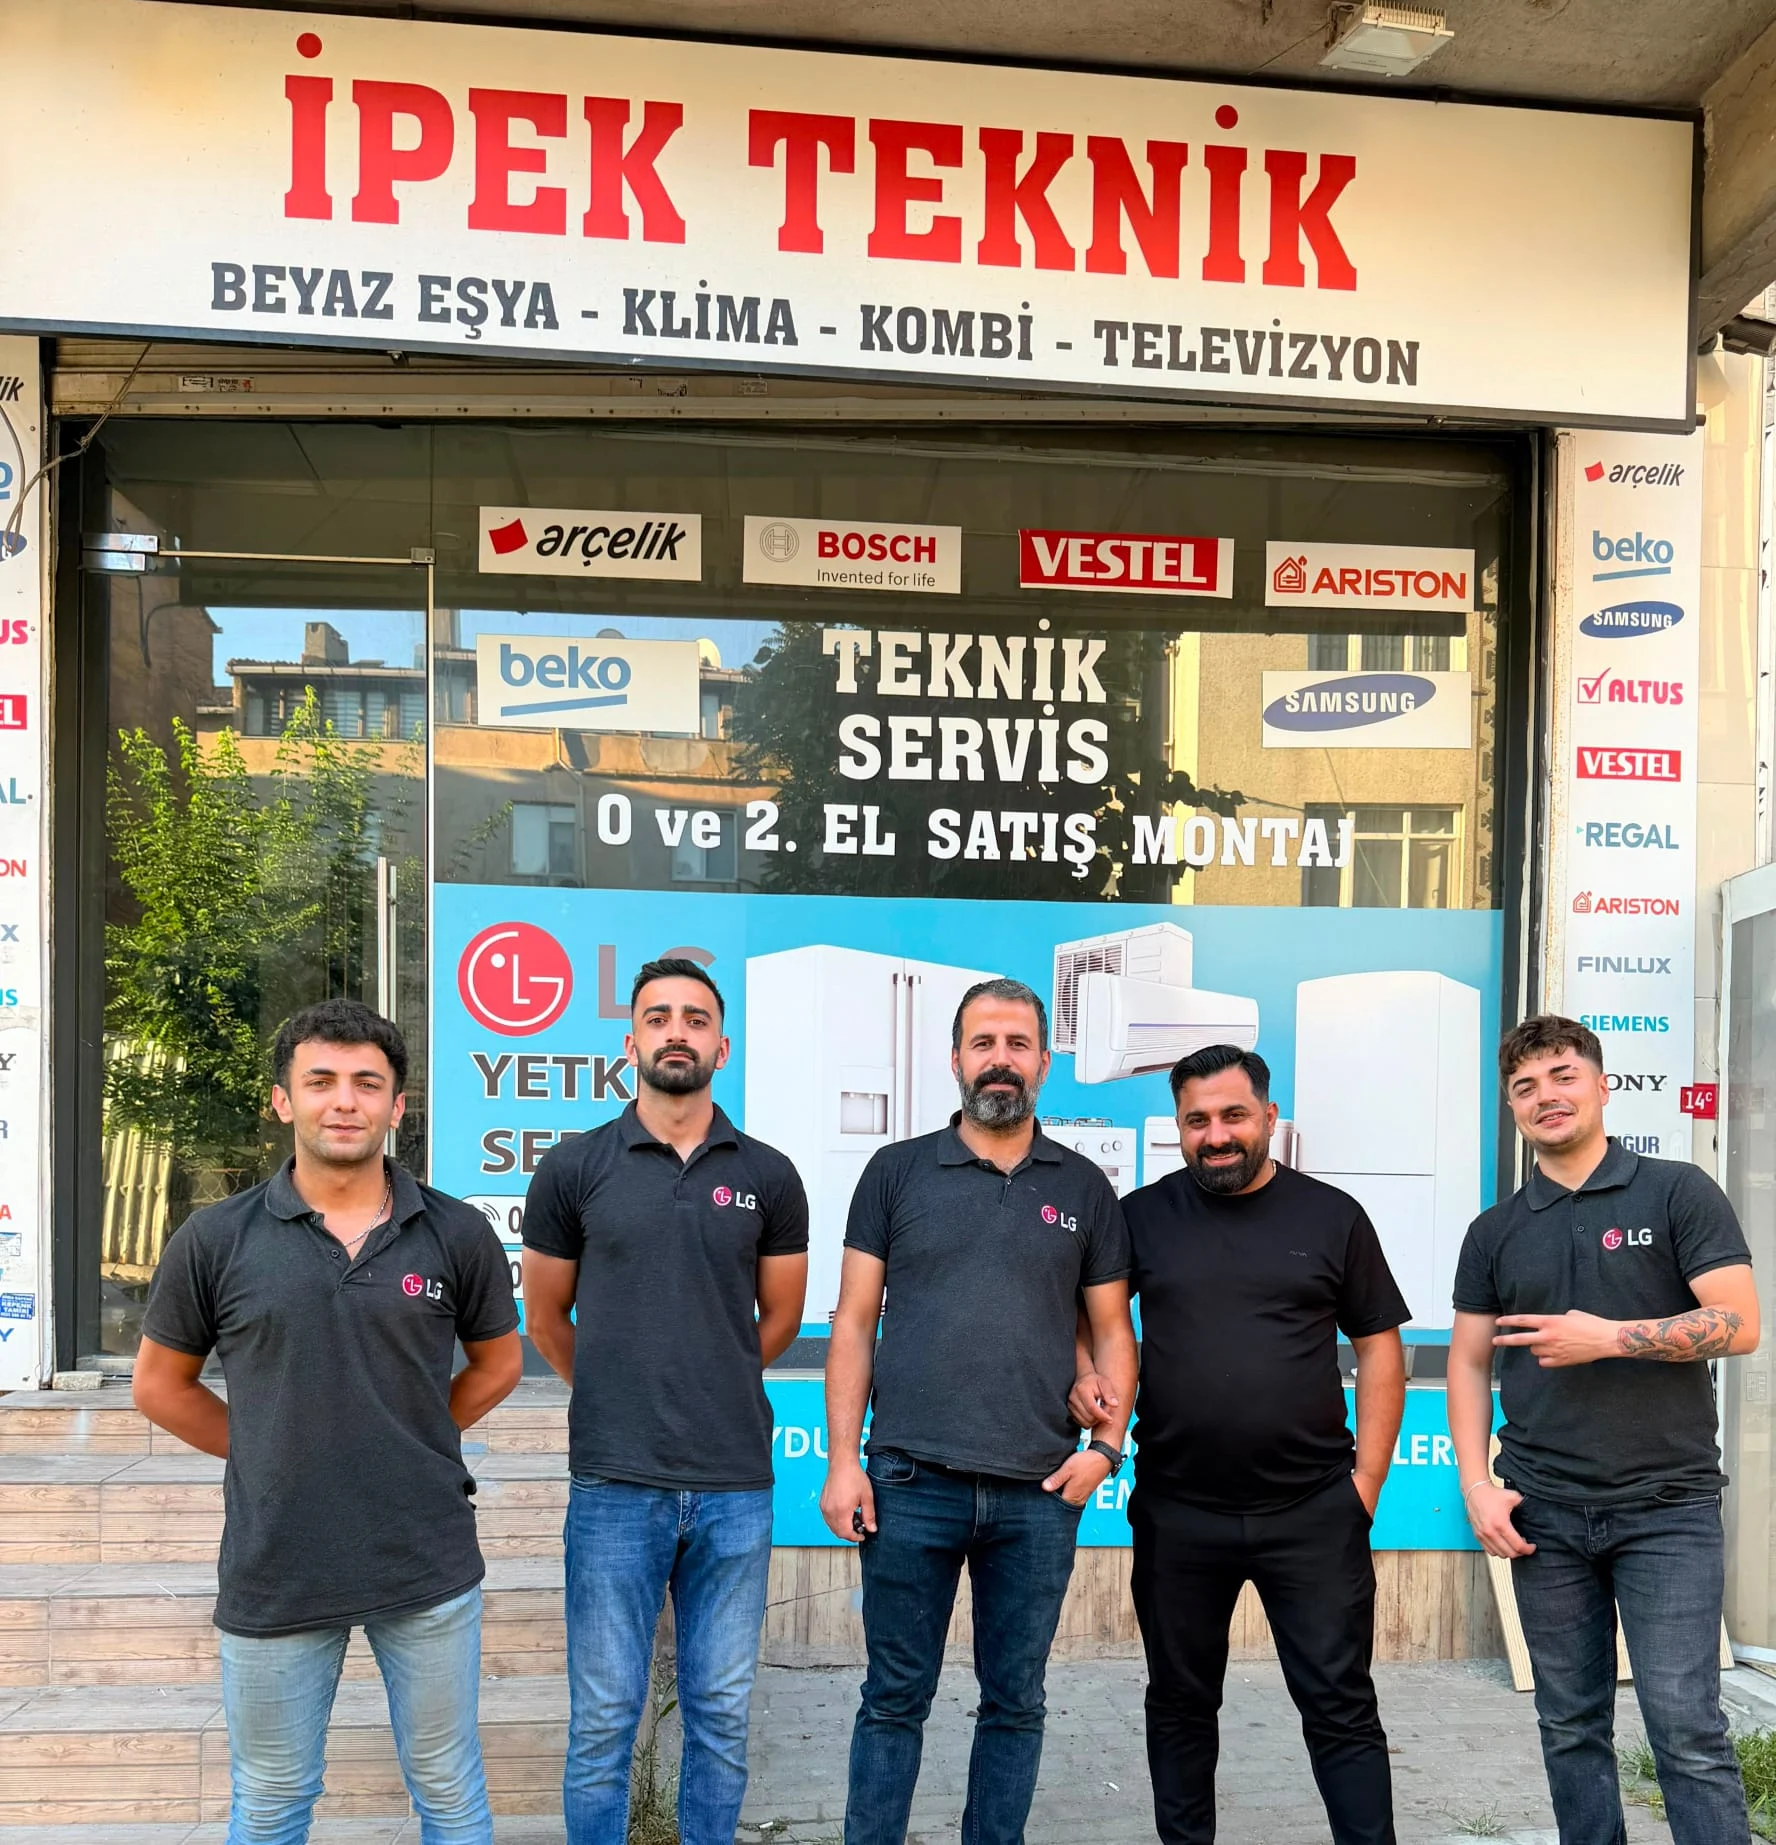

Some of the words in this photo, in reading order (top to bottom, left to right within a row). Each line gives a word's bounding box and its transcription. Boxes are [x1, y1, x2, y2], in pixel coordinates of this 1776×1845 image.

[285, 32, 686, 244] İPEK
[748, 104, 1358, 291] TEKNİK
[211, 262, 394, 320] BEYAZ
[418, 274, 559, 340] EŞYA
[623, 279, 798, 346] KLİMA
[860, 301, 1034, 361] KOMBİ
[1094, 318, 1420, 386] TELEVİZYON
[1608, 462, 1685, 489] arçelik
[536, 521, 687, 568] arçelik
[818, 530, 937, 564] BOSCH
[1592, 530, 1674, 564] beko
[1031, 536, 1208, 584] VESTEL
[817, 568, 884, 585] Invented
[888, 571, 910, 586] for
[913, 573, 936, 588] life
[1311, 566, 1467, 600] ARISTON
[1592, 610, 1673, 630] SAMSUNG
[499, 643, 632, 691] beko
[823, 617, 1108, 704] TEKNİK
[1284, 691, 1416, 714] SAMSUNG
[1608, 678, 1684, 705] ALTUS
[838, 703, 1110, 785] SERVİS
[1582, 750, 1677, 778] VESTEL
[655, 808, 721, 848] ve
[744, 800, 798, 853] 2.
[823, 803, 896, 857] EL
[927, 808, 1098, 879] SATIŞ
[1131, 814, 1355, 869] MONTAJ
[1585, 822, 1680, 850] REGAL
[1594, 897, 1680, 916] ARISTON
[1577, 955, 1672, 975] FINLUX
[1580, 1014, 1670, 1033] SIEMENS
[470, 1052, 639, 1101] YETK
[1605, 1073, 1668, 1092] ONY
[480, 1128, 588, 1176] SE
[735, 1191, 756, 1210] LG
[1060, 1211, 1077, 1232] LG
[1627, 1228, 1653, 1246] LG
[426, 1278, 443, 1300] LG
